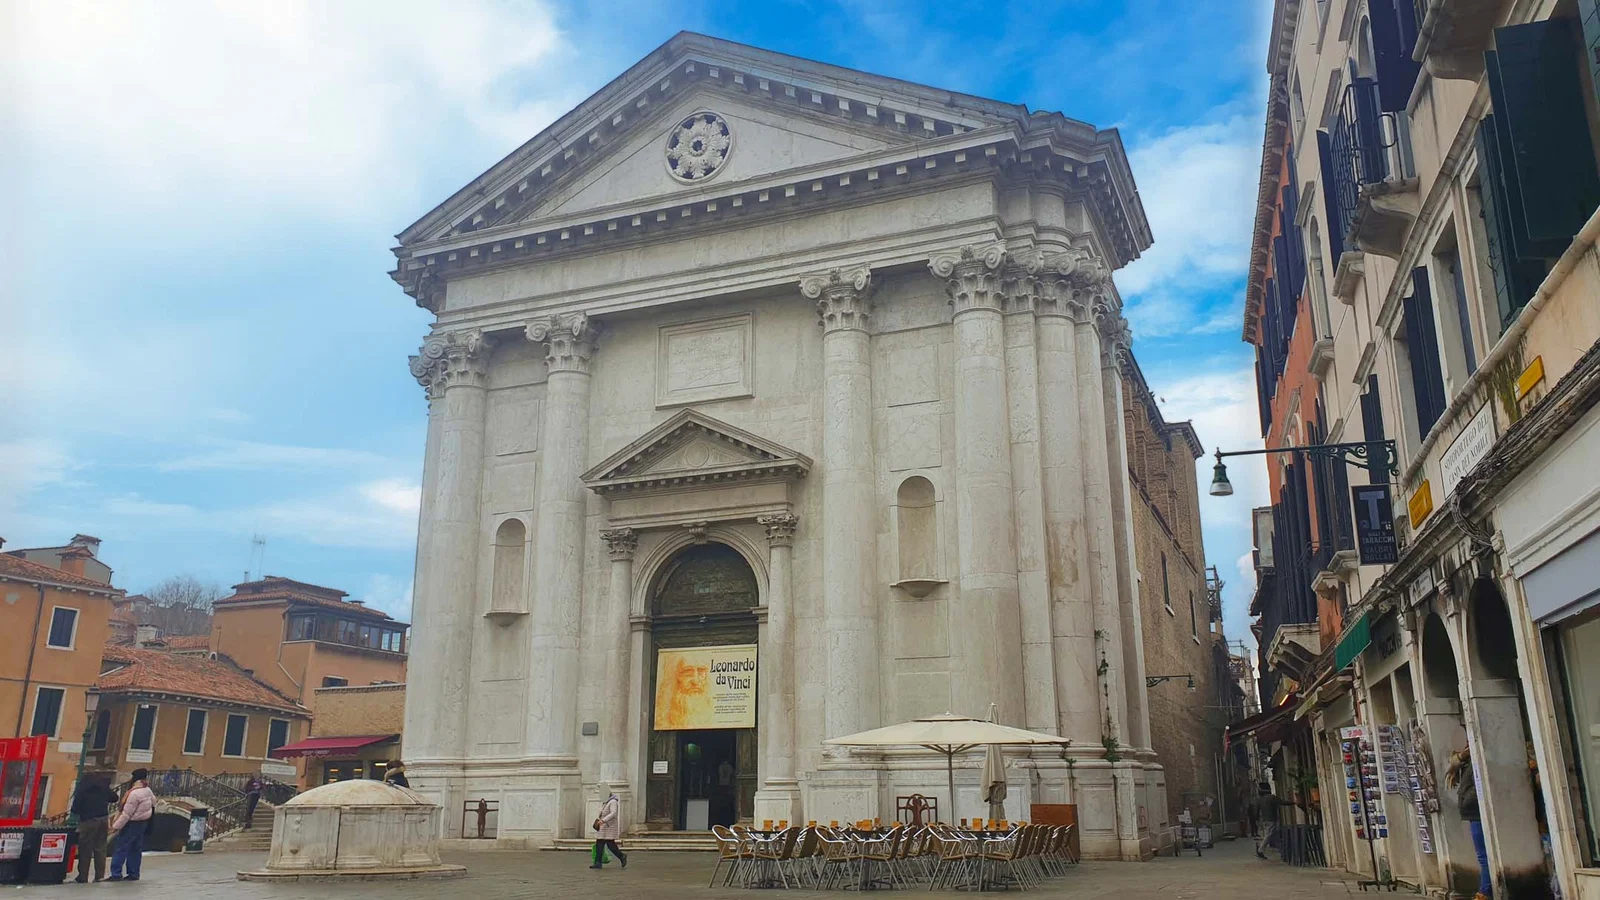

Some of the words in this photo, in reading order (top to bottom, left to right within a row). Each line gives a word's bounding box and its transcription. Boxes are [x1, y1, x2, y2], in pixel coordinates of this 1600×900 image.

[1477, 413, 1489, 434] DEL
[1359, 491, 1384, 529] T
[1361, 536, 1395, 545] TABACCHI
[710, 658, 755, 673] Leonardo
[715, 673, 727, 685] da
[727, 675, 751, 690] Vinci
